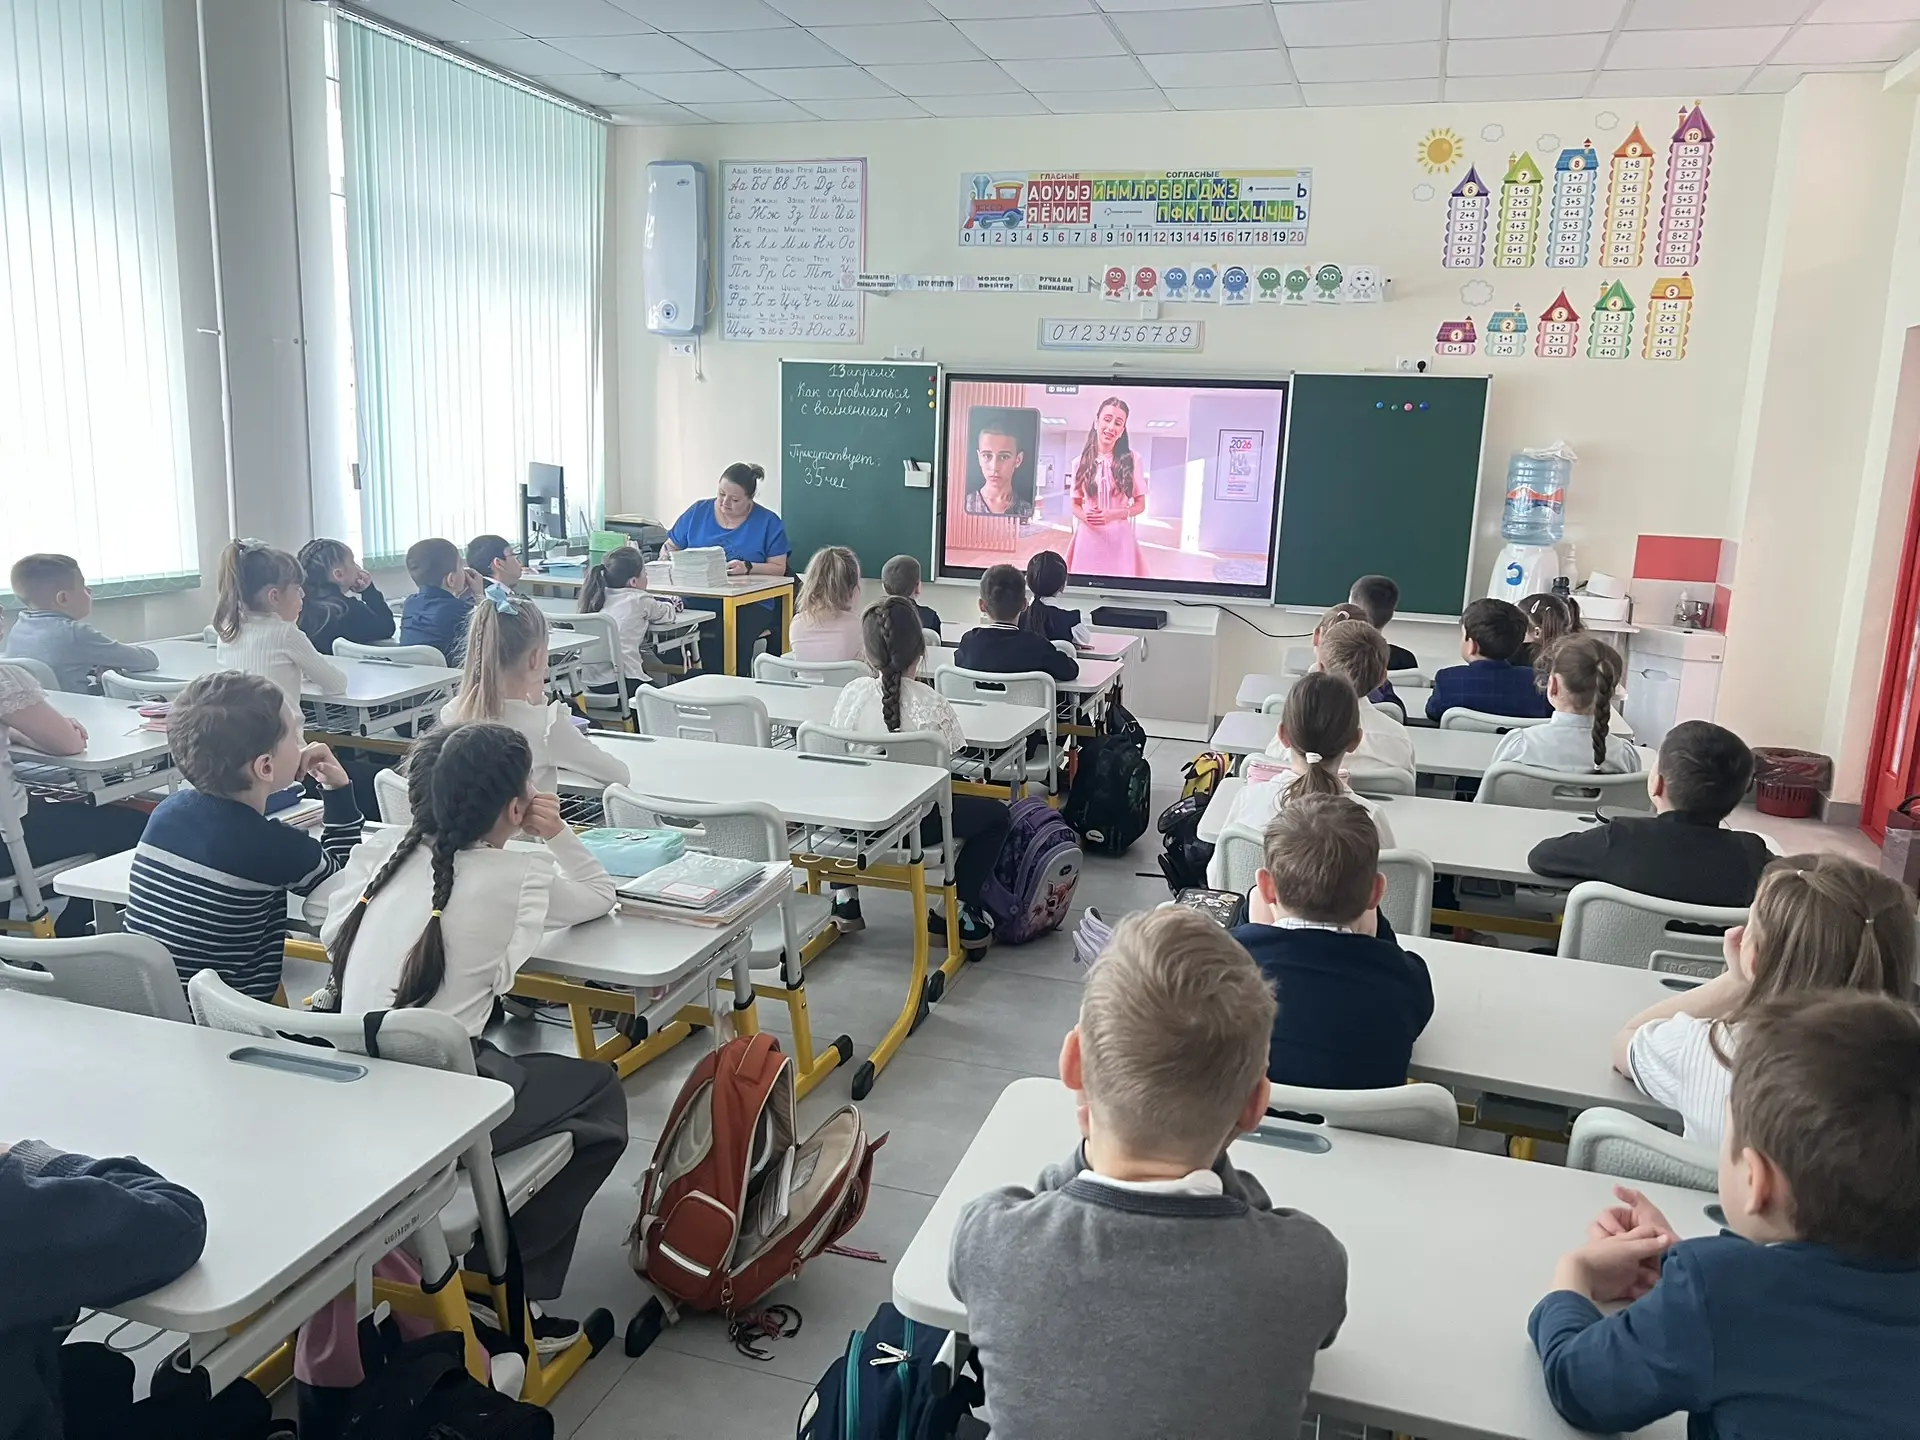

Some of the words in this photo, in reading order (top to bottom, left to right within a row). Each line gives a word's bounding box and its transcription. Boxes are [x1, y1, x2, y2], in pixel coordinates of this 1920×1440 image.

[1688, 132, 1699, 140] 10
[1631, 147, 1637, 155] 9
[1574, 160, 1580, 168] 8
[1625, 160, 1641, 168] 1+8
[1681, 159, 1698, 167] 2+8
[1521, 173, 1527, 181] 7
[1568, 173, 1584, 181] 1+7
[1622, 172, 1639, 180] 2+7
[1680, 171, 1697, 179] 3+7
[1467, 186, 1473, 194] 6
[1514, 187, 1530, 195] 1+6
[1566, 185, 1582, 193] 2+6
[1621, 185, 1638, 193] 3+6
[1678, 183, 1695, 191] 4+6
[1461, 200, 1477, 208] 1+5
[1512, 199, 1528, 207] 2+5
[1565, 197, 1581, 205] 3+5
[1619, 197, 1636, 205] 4+5
[1676, 196, 1693, 204] 5+5
[1511, 211, 1527, 219] 3+4
[1563, 209, 1580, 217] 4+4
[1618, 209, 1635, 217] 5+4
[1675, 207, 1692, 216] 6+4
[1459, 223, 1474, 231] 3+3
[1510, 222, 1526, 230] 4+3
[1562, 221, 1579, 229] 5+3
[1616, 221, 1633, 229] 6+3
[1674, 219, 1690, 228] 7+3
[964, 231, 971, 243] 0
[981, 232, 985, 242] 1
[995, 232, 1002, 242] 2
[1011, 232, 1017, 242] 3
[1026, 232, 1033, 242] 4
[1042, 232, 1049, 242] 5
[1058, 232, 1064, 242] 6
[1074, 232, 1081, 242] 7
[1090, 232, 1097, 242] 8
[1106, 232, 1113, 242] 9
[1120, 232, 1132, 242] 10
[1137, 232, 1149, 242] 11
[1153, 232, 1166, 242] 12
[1169, 232, 1183, 242] 13
[1186, 232, 1199, 242] 14
[1203, 232, 1217, 242] 15
[1220, 232, 1234, 242] 16
[1237, 232, 1251, 242] 17
[1255, 232, 1268, 242] 18
[1272, 232, 1286, 242] 19
[1290, 232, 1304, 242] 20
[1457, 235, 1473, 243] 4+2
[1509, 234, 1525, 242] 5+2
[1561, 233, 1577, 241] 6+2
[1615, 233, 1632, 241] 7+2
[1672, 232, 1688, 240] 8+2
[1507, 246, 1522, 254] 6+1
[1559, 245, 1575, 254] 7+1
[1614, 245, 1629, 253] 8+1
[1670, 244, 1686, 252] 9+1
[1455, 257, 1471, 266] 6+0
[1506, 257, 1522, 265] 7+0
[1558, 257, 1575, 265] 8+0
[1613, 257, 1629, 265] 9+0
[1665, 256, 1687, 264] 10+0
[1669, 288, 1675, 296] 5
[1605, 313, 1621, 321] 1+3
[1660, 314, 1676, 322] 2+3
[1505, 322, 1511, 330] 2
[1551, 324, 1566, 332] 1+2
[1603, 325, 1619, 333] 2+2
[1658, 326, 1675, 334] 3+2
[1498, 335, 1513, 343] 1+1
[1549, 335, 1564, 343] 2+1
[1601, 337, 1616, 345] 3+1
[1447, 345, 1462, 353] 0+1
[1497, 346, 1513, 354] 2+0
[1547, 346, 1564, 354] 3+0
[1655, 349, 1672, 357] 5+0
[829, 364, 845, 378] 13
[846, 368, 896, 385] апреля
[797, 381, 820, 398] Как
[1231, 439, 1252, 449] 2026
[804, 467, 825, 487] 35
